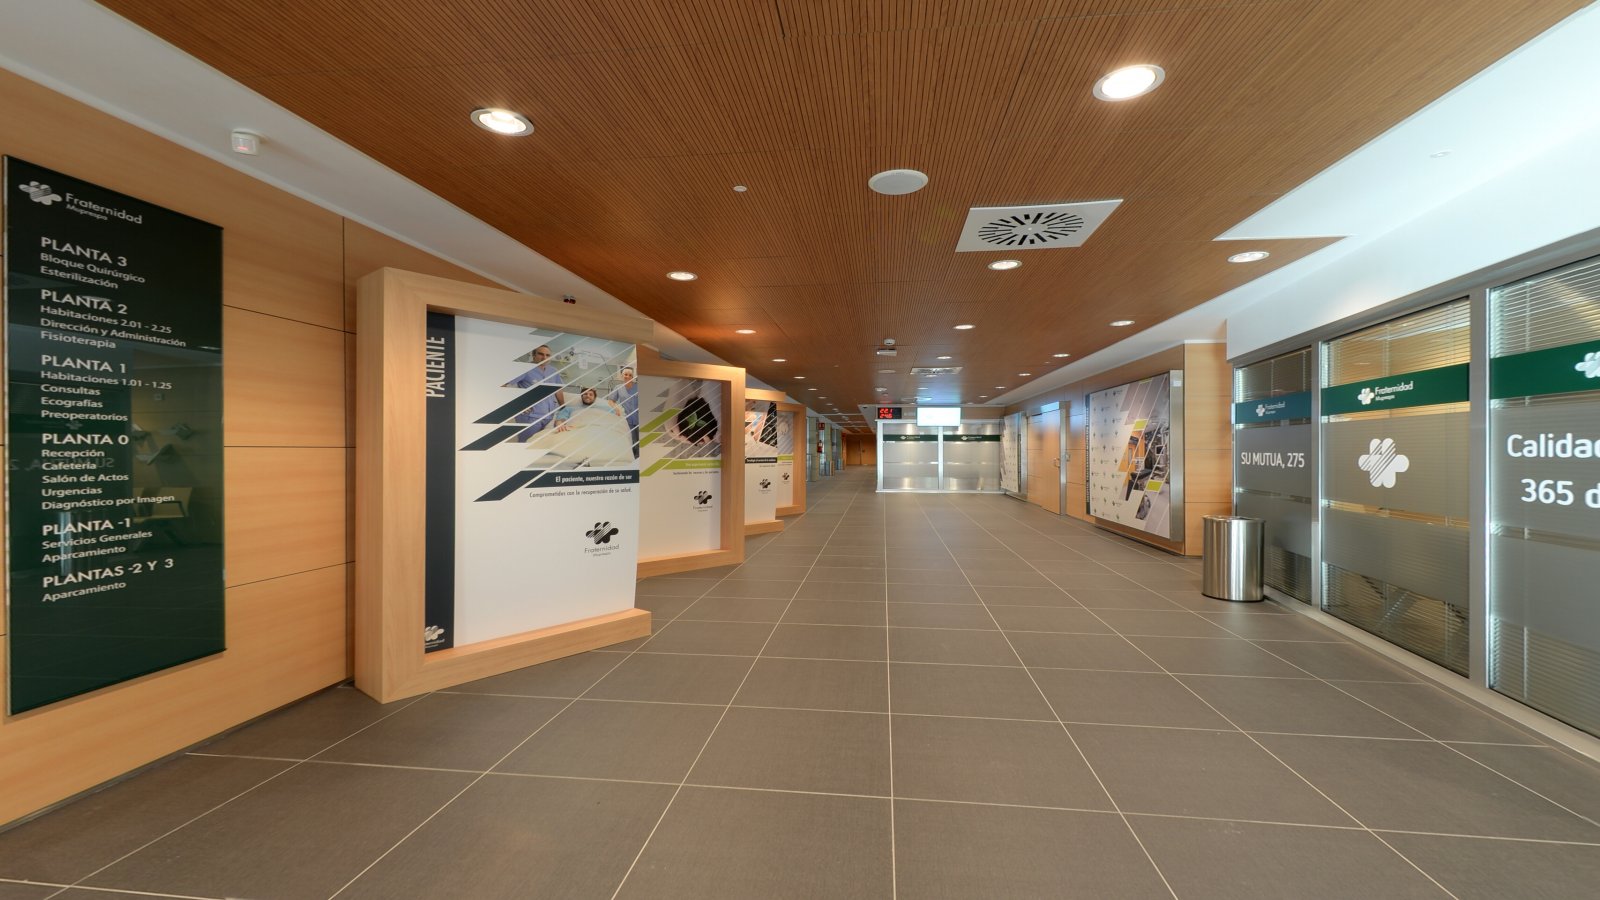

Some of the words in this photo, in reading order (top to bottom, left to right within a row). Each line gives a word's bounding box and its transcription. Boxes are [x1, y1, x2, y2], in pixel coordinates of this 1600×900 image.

[65, 192, 143, 224] Fraternidad
[66, 203, 109, 221] Muprespa
[41, 236, 113, 264] PLANTA
[117, 256, 128, 267] 3
[40, 252, 84, 270] Bloque
[86, 263, 146, 284] Quirúrgico
[40, 265, 118, 289] Esterilización
[41, 289, 113, 312] PLANTA
[117, 303, 128, 315] 2
[40, 305, 118, 325] Habitaciones
[120, 318, 142, 329] 2.01
[151, 323, 172, 334] 2.25
[40, 318, 99, 334] Dirección
[101, 328, 108, 336] y
[110, 329, 186, 347] Administración
[40, 331, 116, 350] Fisioterapia
[41, 354, 113, 372] PLANTA
[119, 363, 126, 373] 1
[40, 370, 119, 385] Habitaciones
[122, 377, 142, 387] 1.01
[152, 380, 172, 389] 1.25
[1374, 381, 1414, 395] Fraternidad
[40, 384, 101, 396] Consultas
[41, 410, 128, 421] Preoperatorios
[42, 433, 113, 445] PLANTA
[118, 434, 129, 445] 0
[1507, 433, 1600, 458] Calida
[41, 449, 105, 458] Recepción
[1240, 452, 1251, 465] SU
[1252, 453, 1285, 469] MUTUA,
[1287, 453, 1305, 468] 275
[42, 462, 97, 470] Cafetería
[42, 474, 77, 484] Salón
[79, 474, 96, 482] de
[97, 473, 129, 482] Actos
[555, 475, 561, 483] El
[41, 487, 103, 498] Urgencias
[1520, 478, 1575, 506] 365
[41, 497, 114, 510] Diagnóstico
[116, 497, 135, 506] por
[137, 494, 175, 504] Imagen
[42, 520, 114, 536] PLANTA
[118, 518, 131, 528] -1
[42, 537, 97, 550] Servicios
[99, 530, 153, 543] Generales
[42, 546, 126, 563] Aparcamiento
[42, 565, 124, 588] PLANTAS
[128, 563, 142, 574] -2
[147, 561, 157, 570] Y
[164, 558, 174, 568] 3
[42, 581, 126, 602] Aparcamiento
